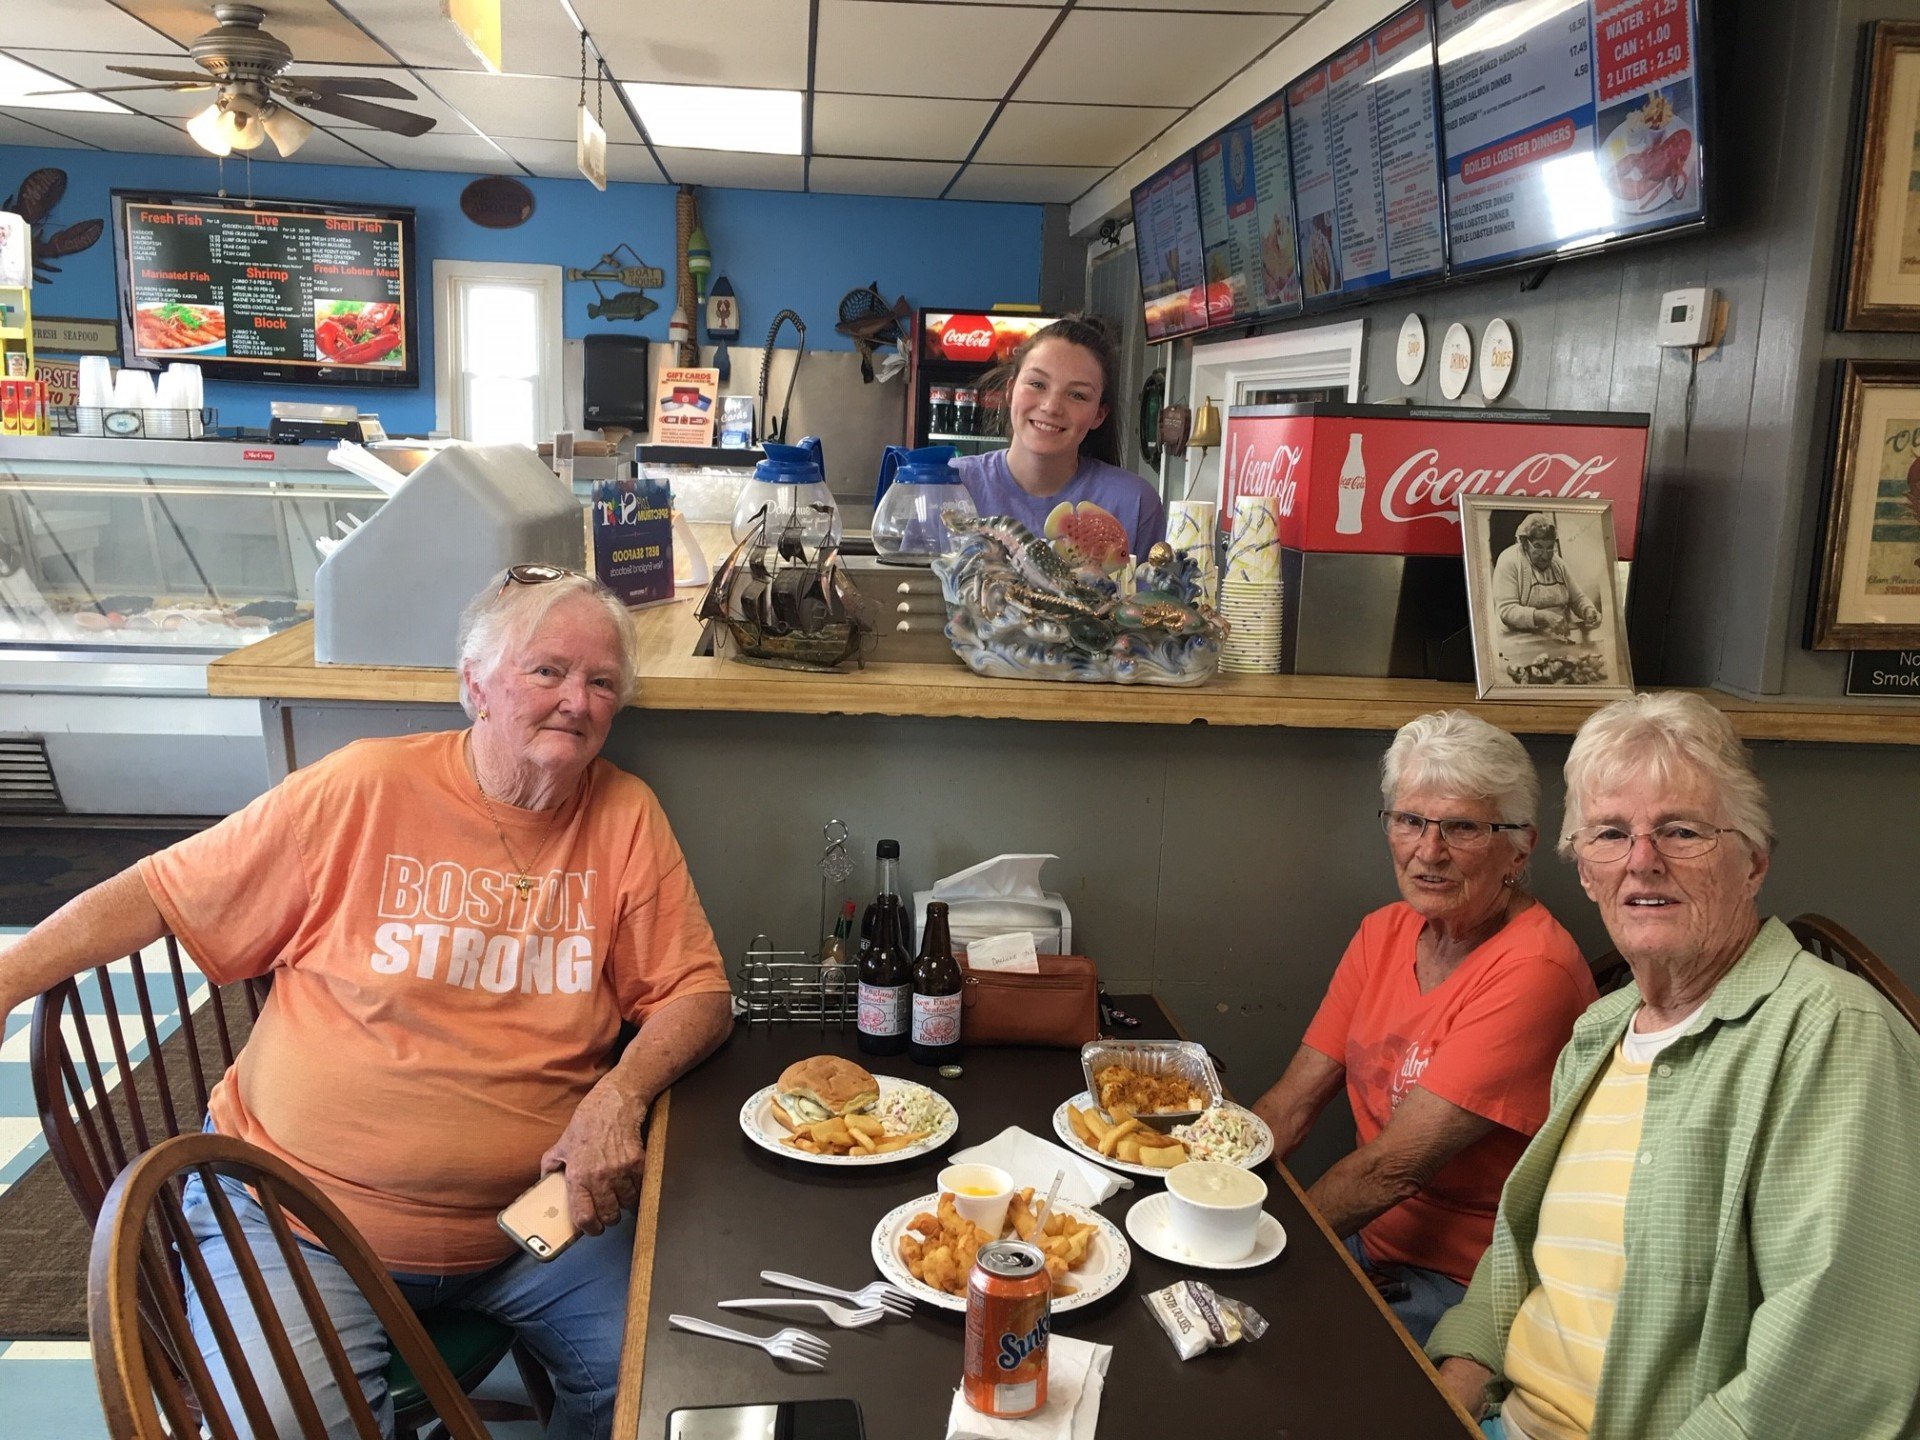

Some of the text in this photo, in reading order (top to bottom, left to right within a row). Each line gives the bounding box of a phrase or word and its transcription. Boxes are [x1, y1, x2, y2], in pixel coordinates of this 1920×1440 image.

[1606, 0, 1678, 40] WATER 1.25
[1614, 23, 1670, 61] CAN 1.00
[1456, 68, 1478, 87] STUFFED
[1479, 58, 1498, 75] BAKED
[1499, 43, 1527, 65] HADDOCK
[1607, 44, 1681, 89] 2 LITER 2.50
[1468, 83, 1490, 101] SALMON
[1491, 73, 1512, 91] DINNER
[1464, 156, 1491, 177] BOILED
[1493, 140, 1530, 166] LOBSTER
[1532, 125, 1572, 152] DINNERS
[1469, 200, 1492, 214] LOBSTER
[1494, 192, 1514, 206] DINNER
[140, 211, 203, 225] Fresh Fish
[254, 214, 278, 225] Live
[325, 219, 382, 233] Shell Fish
[1465, 215, 1487, 229] LOBSTER
[1489, 208, 1509, 221] DINNER
[1470, 226, 1493, 239] LOBSTER
[1494, 221, 1515, 234] DINNER
[142, 270, 210, 282] Marinated Fish
[246, 267, 288, 282] Shrimp
[314, 264, 339, 274] Fresh
[341, 266, 374, 276] Lobster
[376, 268, 399, 277] Meat
[628, 269, 655, 277] BOAT
[630, 278, 660, 287] HOUSE
[254, 317, 287, 329] Block
[33, 328, 99, 342] FRESH SEAFOOD
[943, 329, 993, 347] Coca-Cola
[34, 366, 80, 389] OBSTE
[685, 372, 712, 380] CARDS
[49, 391, 63, 405] TO
[721, 411, 748, 422] Cards
[1872, 670, 1920, 686] Smok
[378, 854, 598, 932] BOSTON
[370, 922, 592, 995] STRONG
[1172, 1306, 1194, 1335] CRACKERS
[996, 1314, 1050, 1372] Sunk
